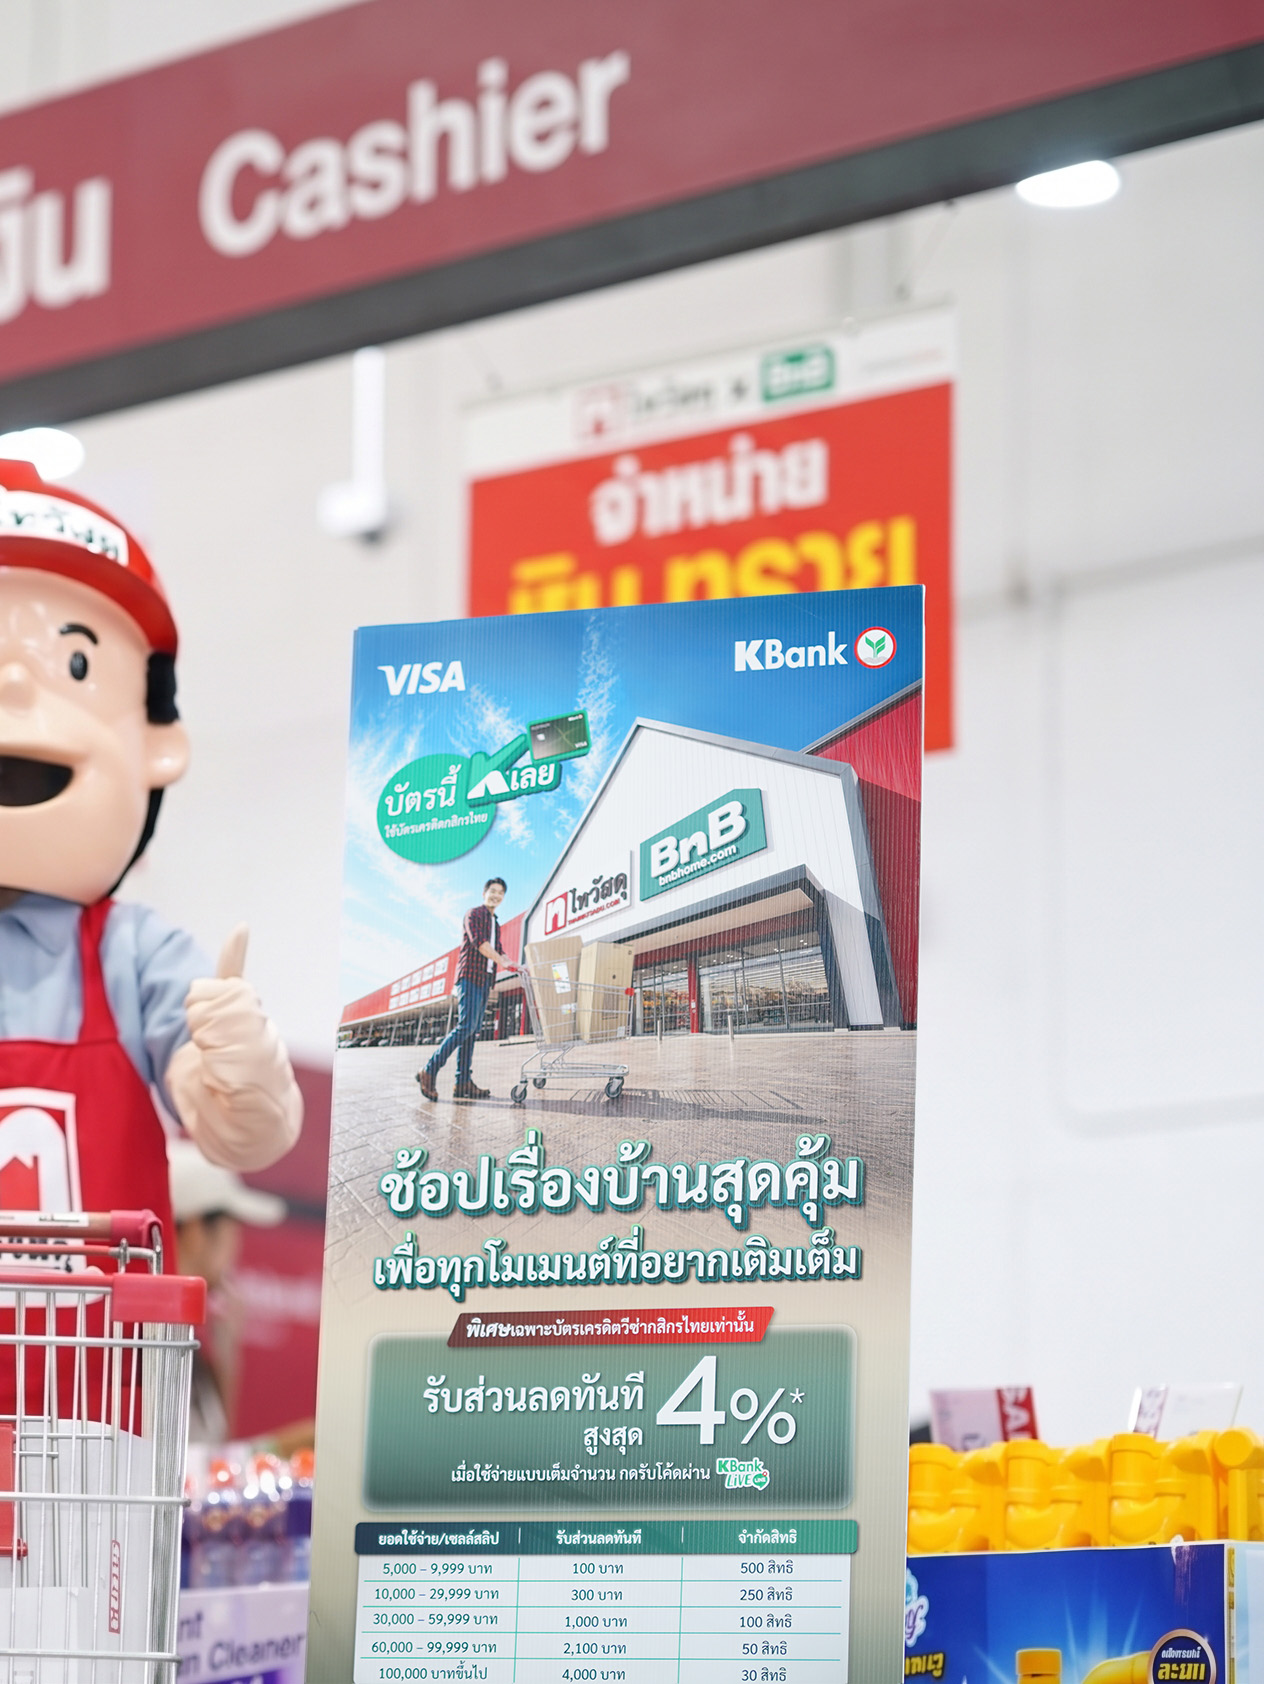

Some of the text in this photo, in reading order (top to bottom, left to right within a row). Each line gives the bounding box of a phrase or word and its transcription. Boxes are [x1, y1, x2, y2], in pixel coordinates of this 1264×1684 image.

[199, 50, 628, 256] Cashier
[589, 432, 830, 546] จำหน่าย
[734, 631, 849, 672] KBank
[377, 661, 466, 696] VISA
[650, 800, 747, 879] BnB
[658, 844, 737, 888] bnbhome.com
[380, 1129, 860, 1225] ช้อปเรื่องบ้านสุดคุ้ม
[373, 1226, 858, 1299] เพื่อทุกโมเมนต์ที่อยากเติมเต็ม
[422, 1370, 645, 1414] รับส่วนลดทันที
[583, 1425, 643, 1456] สูงสุด
[451, 1459, 762, 1483] เมื่อใช้จ่ายแบบเต็มจำนวน กดรับโค้ดผ่าน KBank
[379, 1529, 500, 1546] ยอดใช้จ่าย/เซลล์สลิป
[556, 1529, 642, 1545] รับส่วนลดทันที
[738, 1529, 797, 1545] จำกัดสิทธิ
[383, 1563, 417, 1576] 5,000
[430, 1563, 465, 1576] 9,999
[468, 1564, 493, 1575] บาท
[573, 1562, 624, 1575] 100 บาท
[740, 1559, 794, 1575] 500 สิทธิ
[375, 1588, 416, 1602] 10,000
[429, 1588, 471, 1602] 29,999
[475, 1589, 499, 1600] บาท
[571, 1589, 623, 1601] 300 บาท
[739, 1586, 793, 1602] 250 สิทธิ
[373, 1613, 415, 1627] 30,000
[428, 1613, 470, 1627] 59,999
[474, 1614, 498, 1626] บาท
[565, 1616, 628, 1630] 1,000 บาท
[739, 1613, 792, 1629] 100 สิทธิ
[209, 1634, 304, 1671] Cleaner
[371, 1641, 413, 1655] 60,000
[427, 1641, 469, 1655] 99,999
[472, 1642, 497, 1654] บาท
[563, 1643, 627, 1656] 2,100 บาท
[742, 1640, 787, 1656] 50 สิทธิ
[379, 1660, 488, 1682] 100,000 บาทขึ้นไป
[562, 1669, 626, 1683] 4,000 บาท
[742, 1666, 787, 1682] 30 สิทธิ
